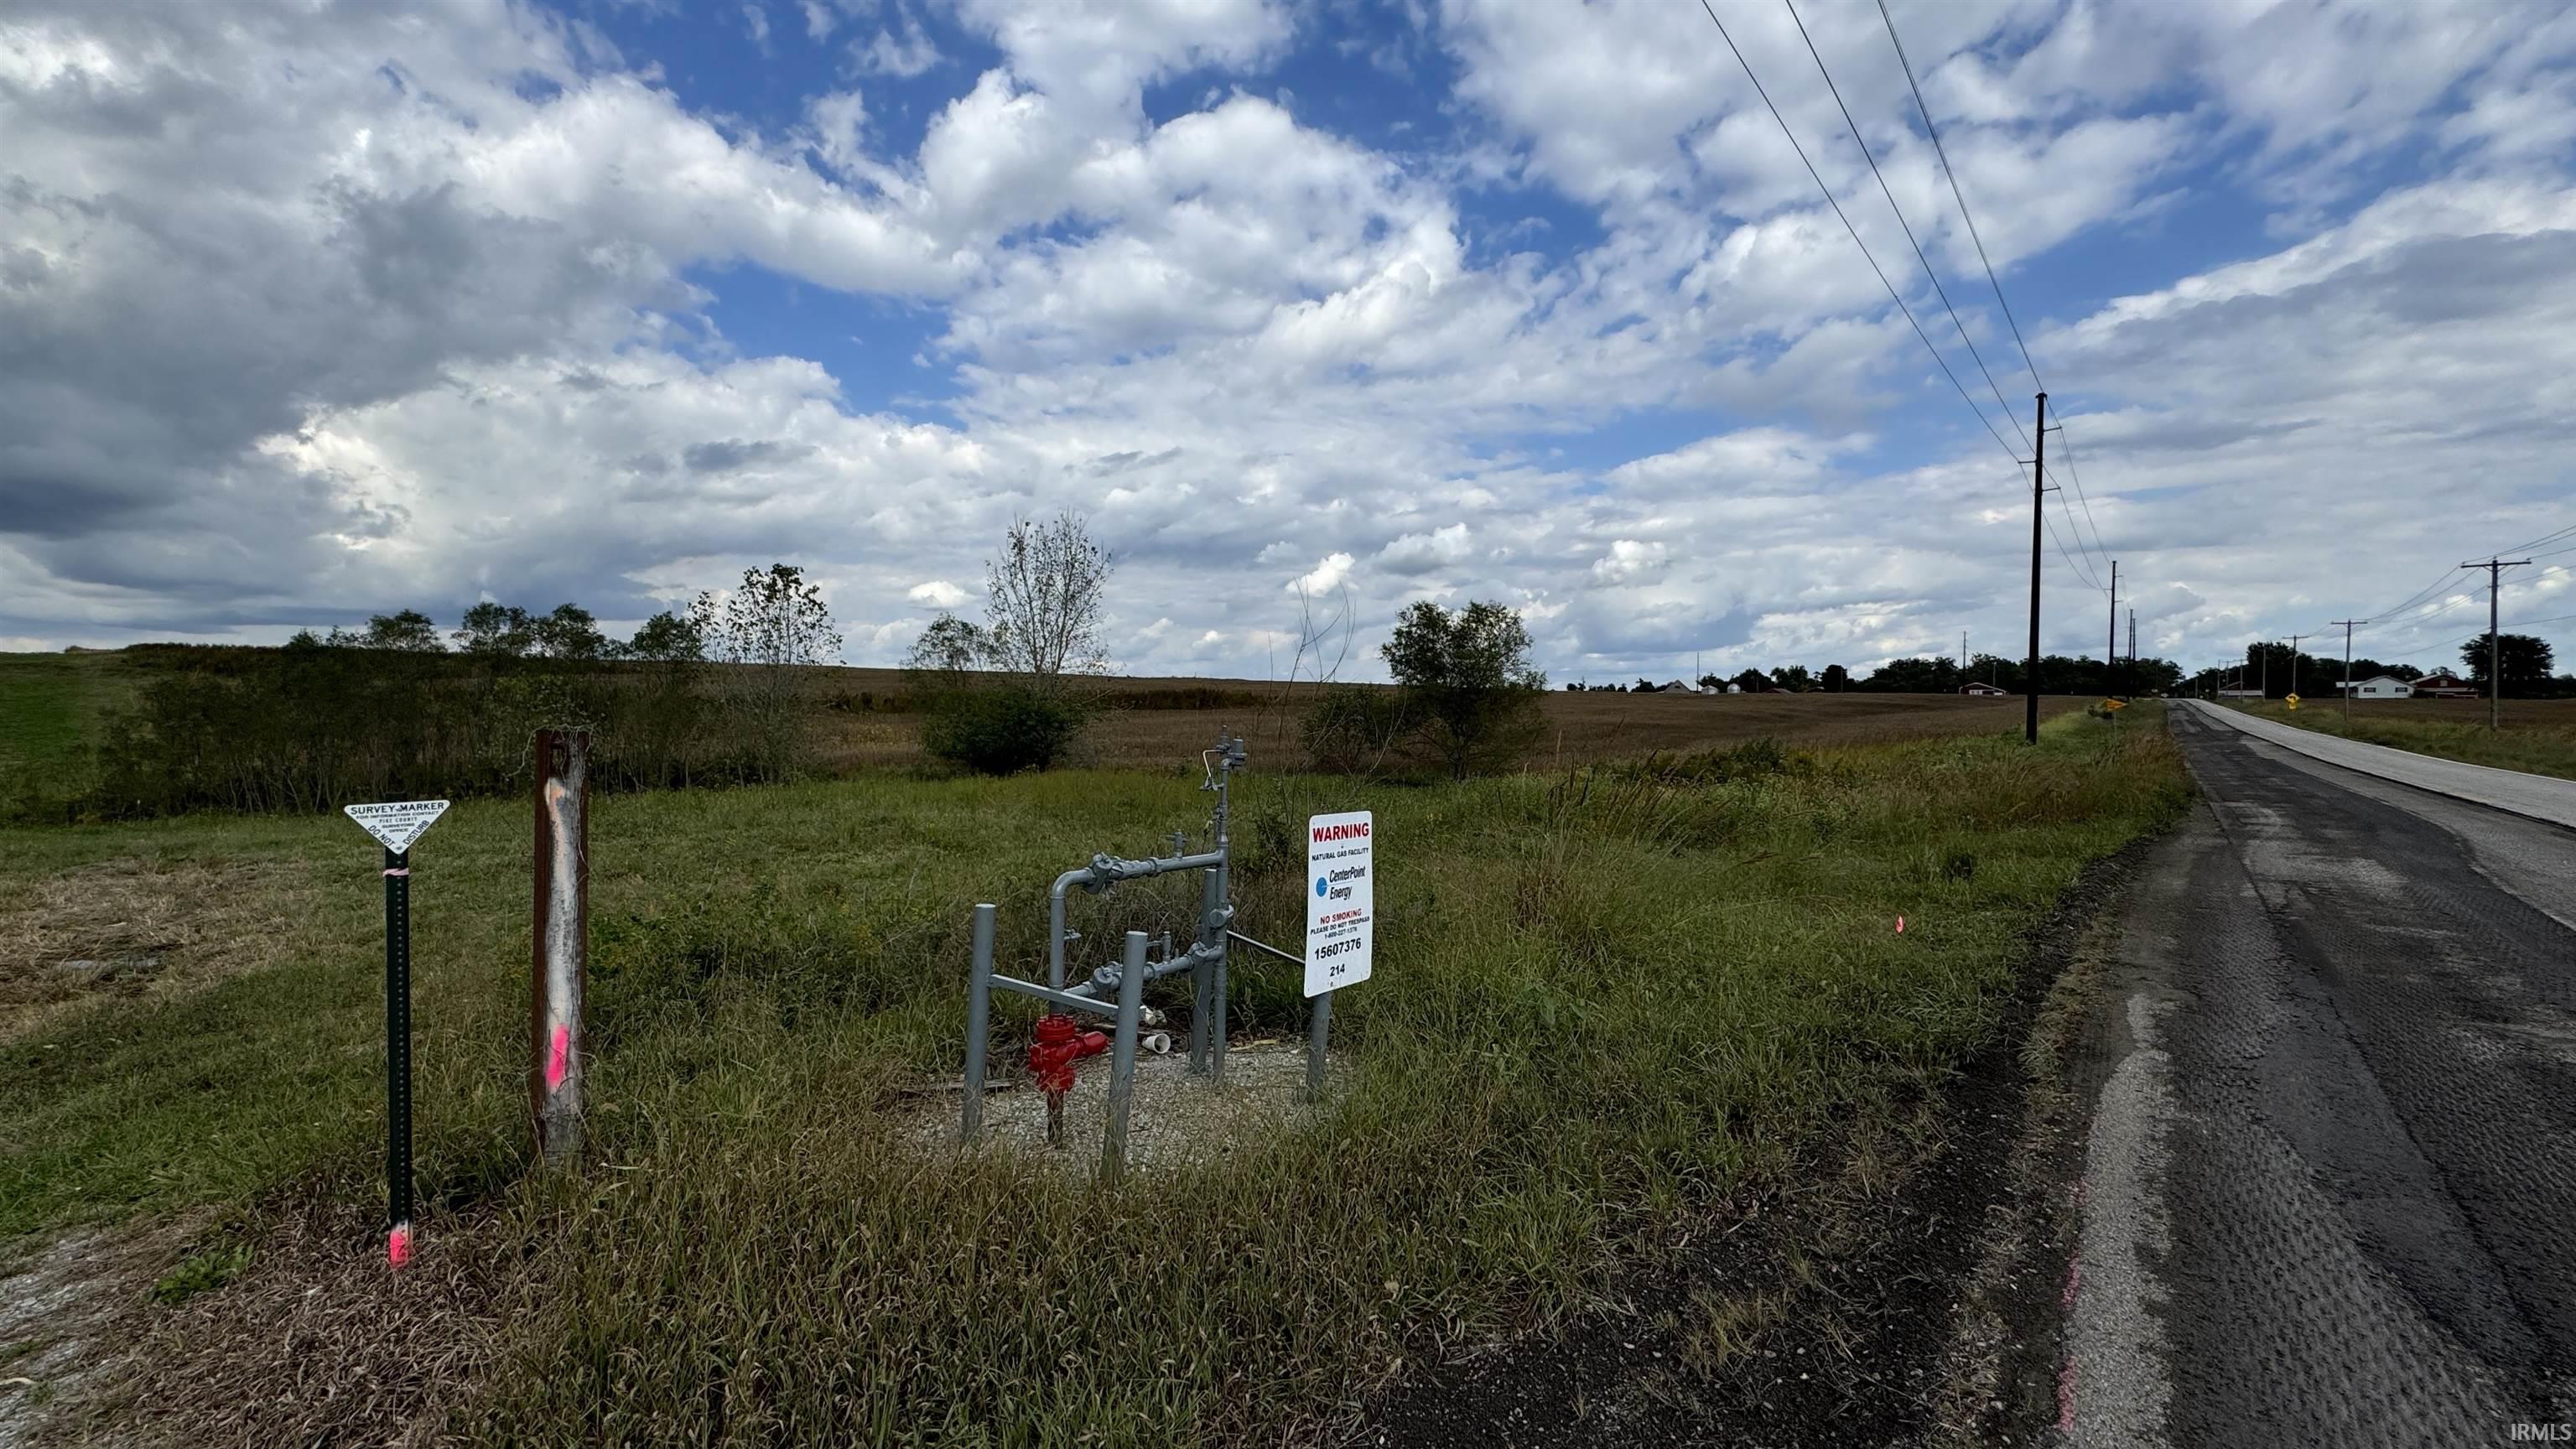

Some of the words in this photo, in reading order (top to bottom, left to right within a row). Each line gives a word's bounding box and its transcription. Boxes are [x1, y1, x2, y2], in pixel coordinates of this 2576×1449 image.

[351, 805, 397, 815] SURVEY
[401, 802, 444, 812] MARKER
[368, 825, 381, 835] DO
[380, 834, 396, 847] NOT
[402, 820, 429, 845] DISTURB
[1313, 823, 1369, 843] WARNING
[1312, 853, 1336, 861] NATURAL
[1330, 865, 1366, 883] CenterPoint
[1330, 886, 1353, 900] Energy
[1321, 916, 1330, 926] NO
[1332, 908, 1362, 922] SMOKING
[1311, 926, 1328, 936] PLEASE
[1348, 917, 1369, 926] TRESPASS
[1315, 938, 1361, 959] 15607376
[1330, 963, 1345, 977] 214
